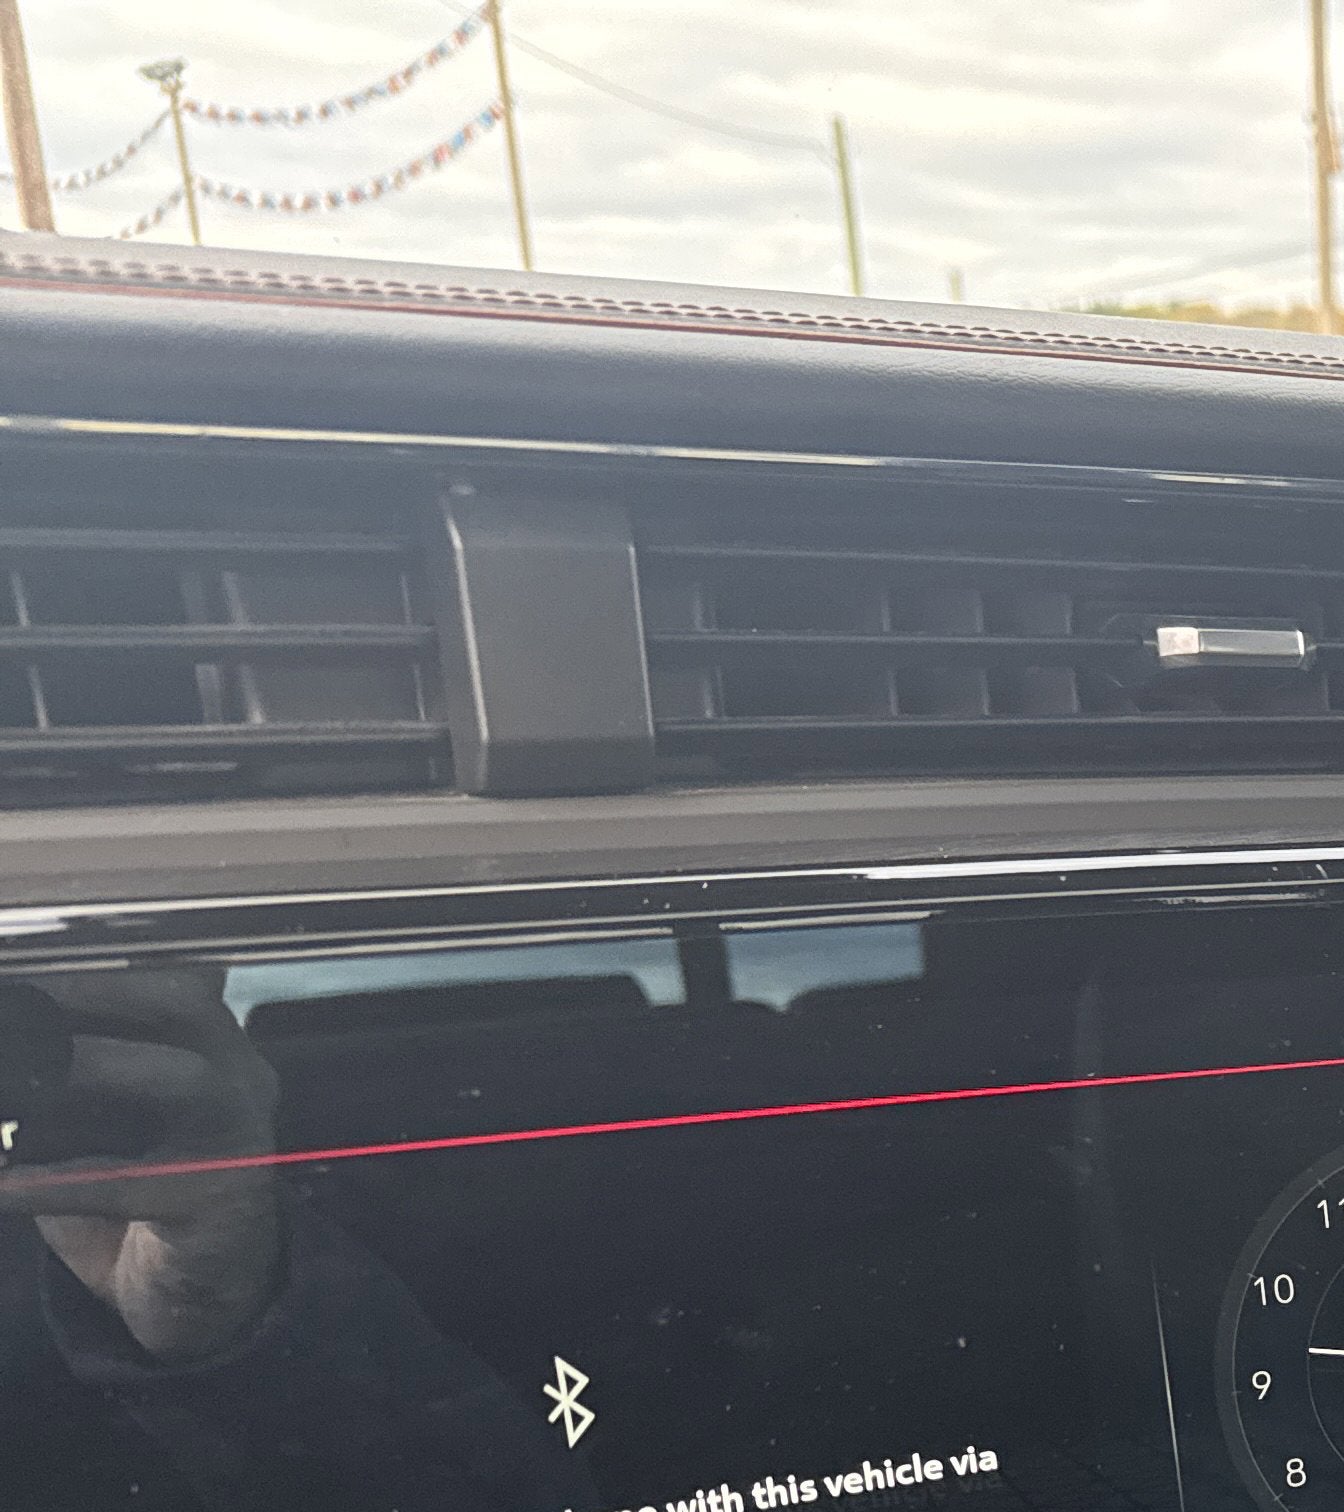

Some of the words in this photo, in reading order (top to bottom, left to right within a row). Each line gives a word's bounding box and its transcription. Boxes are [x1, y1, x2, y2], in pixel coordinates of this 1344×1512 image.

[1254, 1273, 1295, 1306] 10
[1251, 1370, 1272, 1400] 9
[751, 1474, 818, 1510] this
[823, 1452, 944, 1497] vehicle
[949, 1445, 998, 1476] via
[1286, 1457, 1307, 1488] 8
